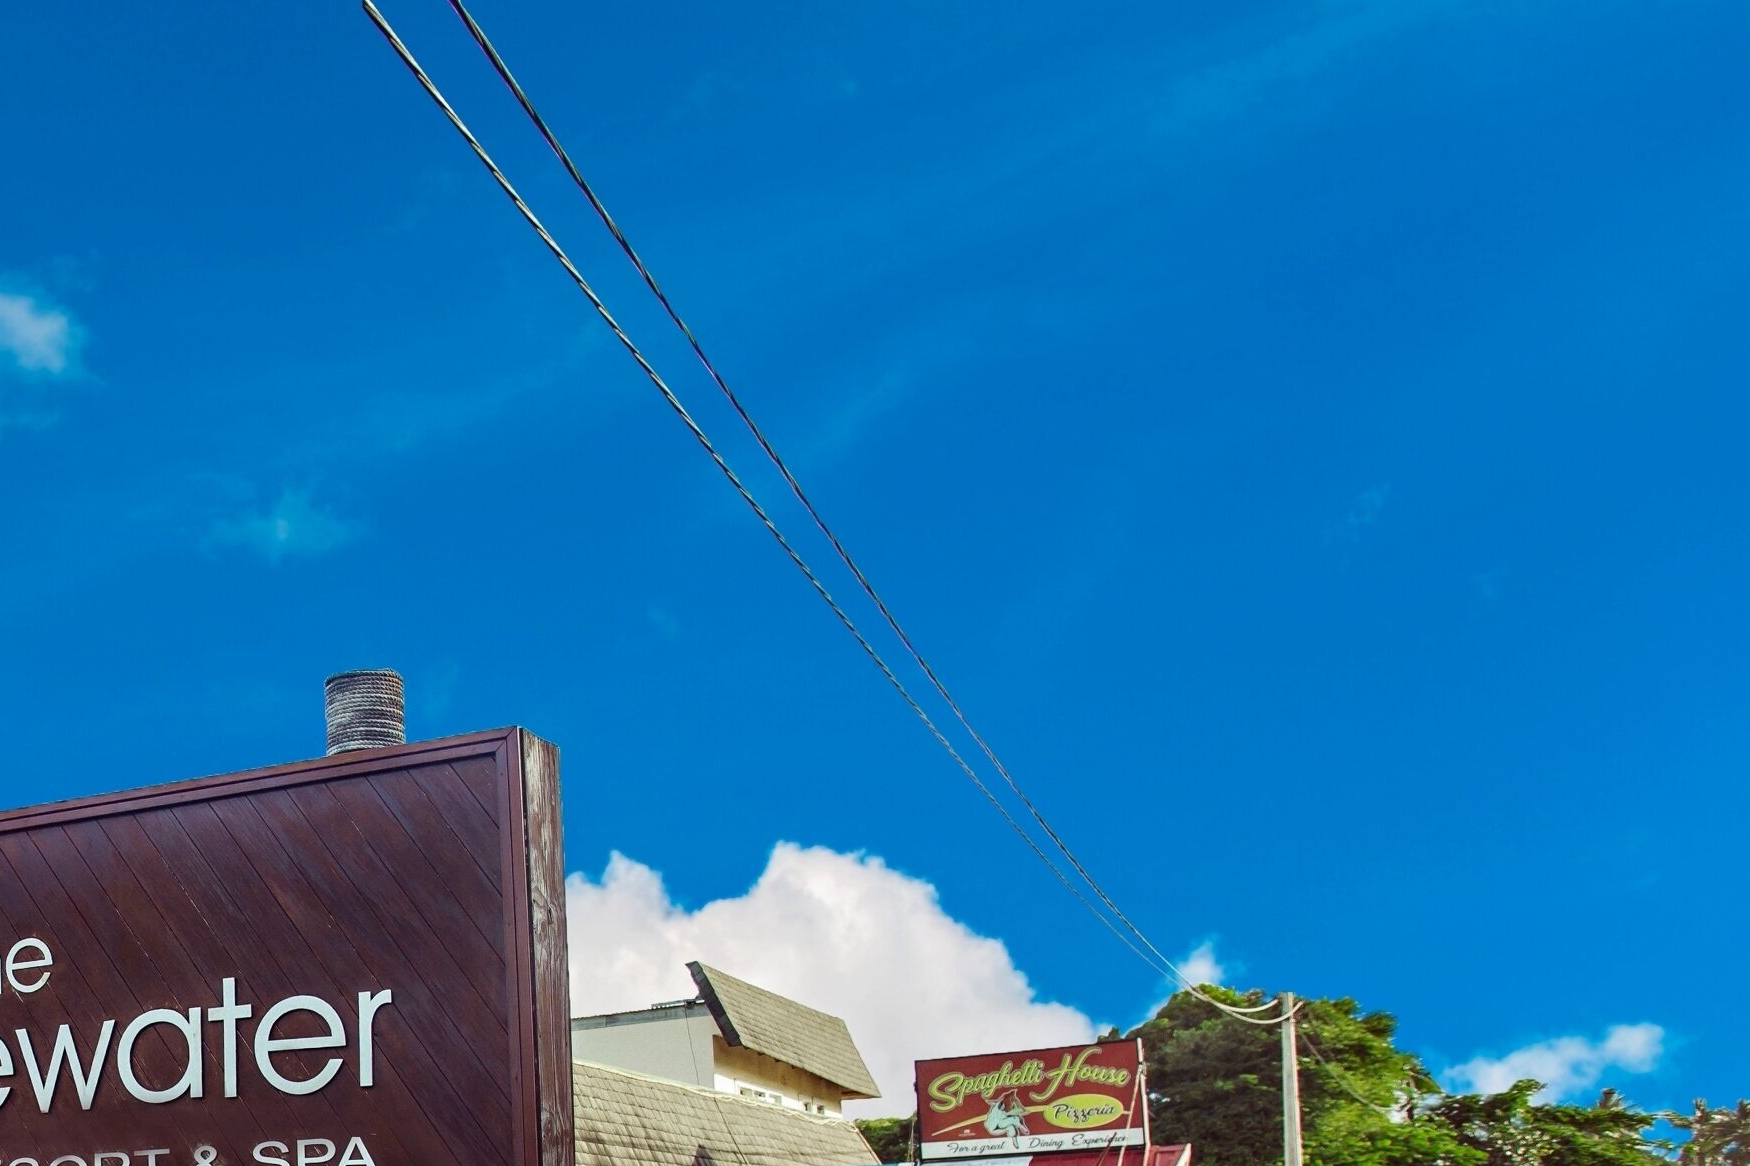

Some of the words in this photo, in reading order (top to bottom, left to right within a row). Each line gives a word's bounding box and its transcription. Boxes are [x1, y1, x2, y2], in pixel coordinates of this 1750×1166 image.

[927, 1056, 1046, 1113] Spaghetti
[1028, 1046, 1131, 1101] House
[1051, 1103, 1117, 1124] Pizzeria
[946, 1141, 969, 1154] For
[978, 1141, 1006, 1154] great
[1028, 1136, 1065, 1150] Dining
[1070, 1133, 1127, 1146] Experince
